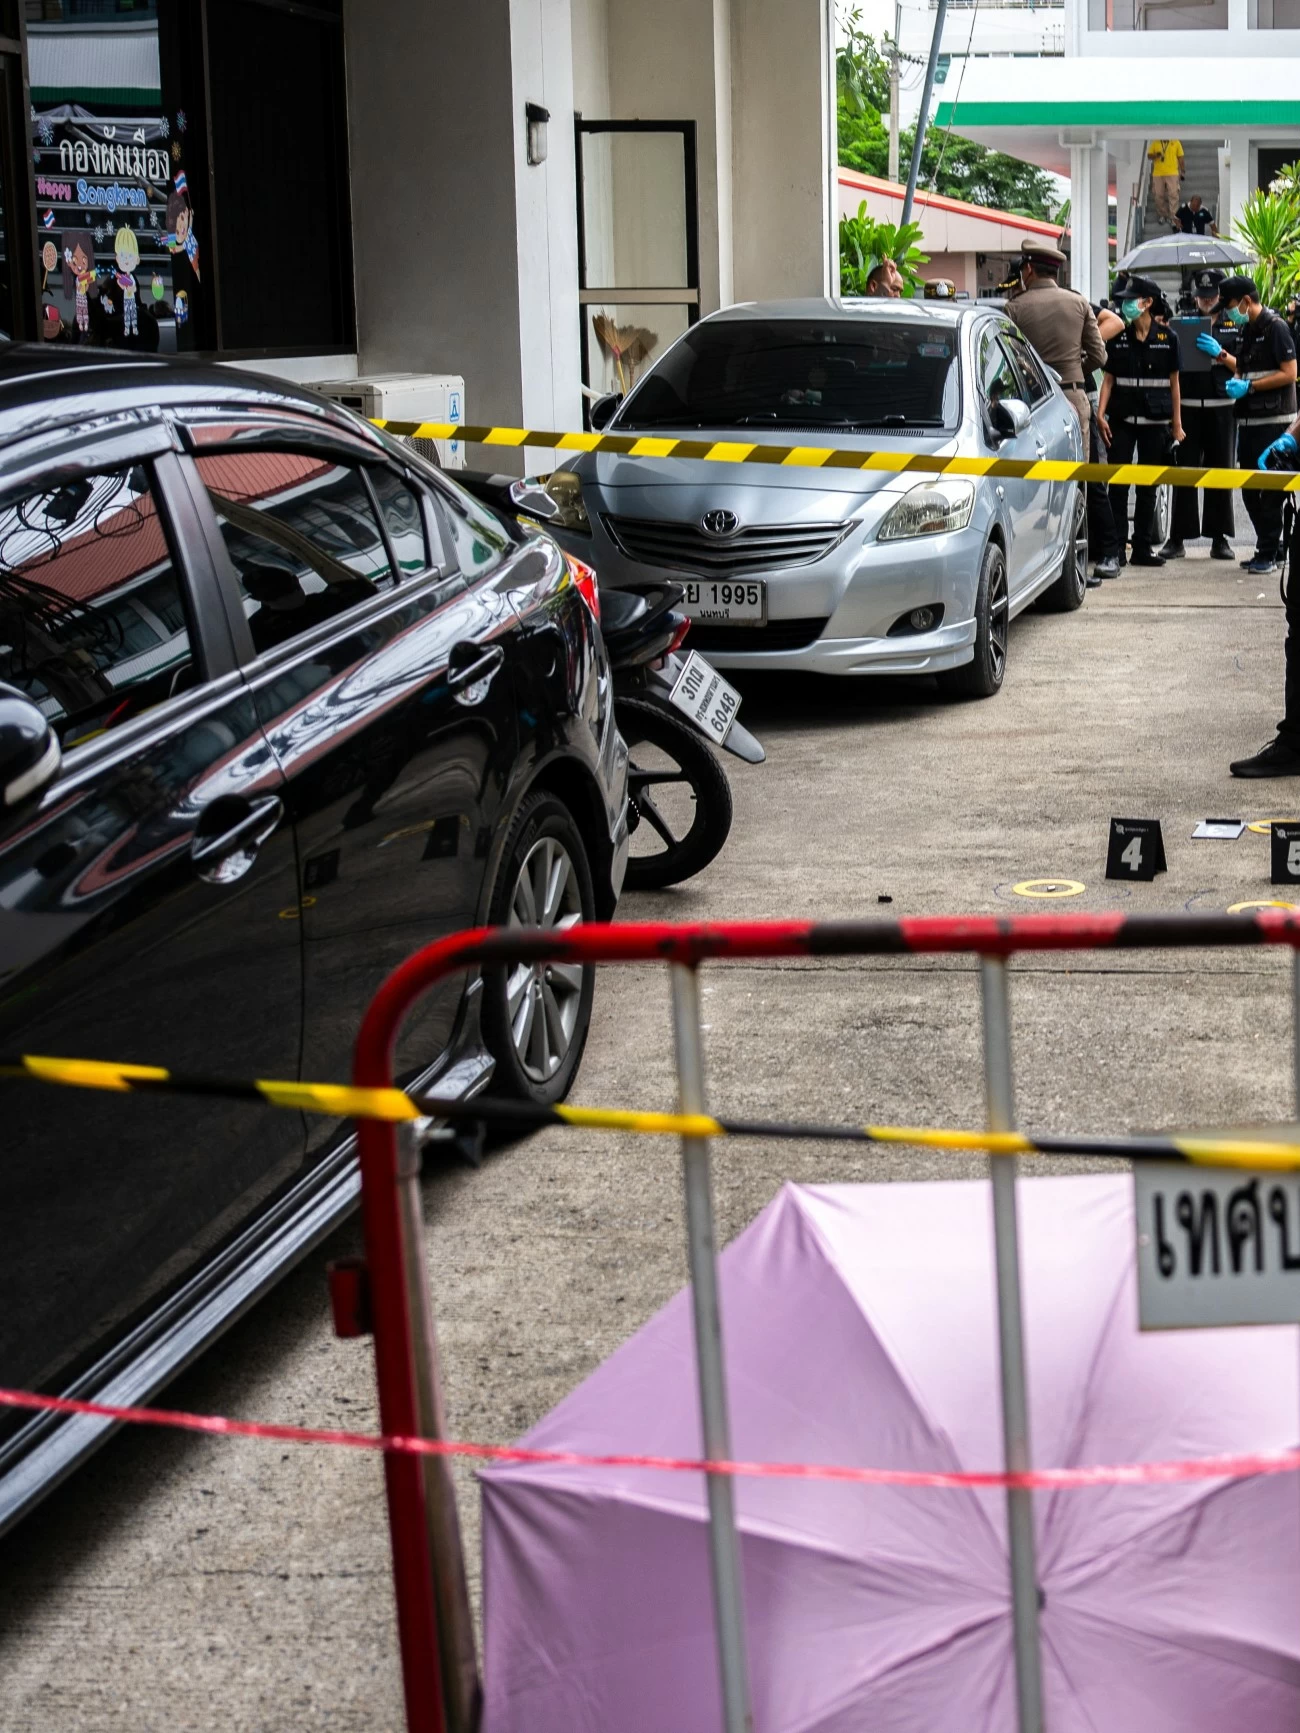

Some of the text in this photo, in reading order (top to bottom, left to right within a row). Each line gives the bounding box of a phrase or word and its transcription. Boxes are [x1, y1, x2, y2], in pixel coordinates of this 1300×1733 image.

[59, 125, 171, 181] กองผังเมือง
[37, 177, 147, 213] Happy Songkran
[710, 584, 758, 605] 1995
[711, 692, 736, 733] 6048
[1120, 836, 1143, 872] 4
